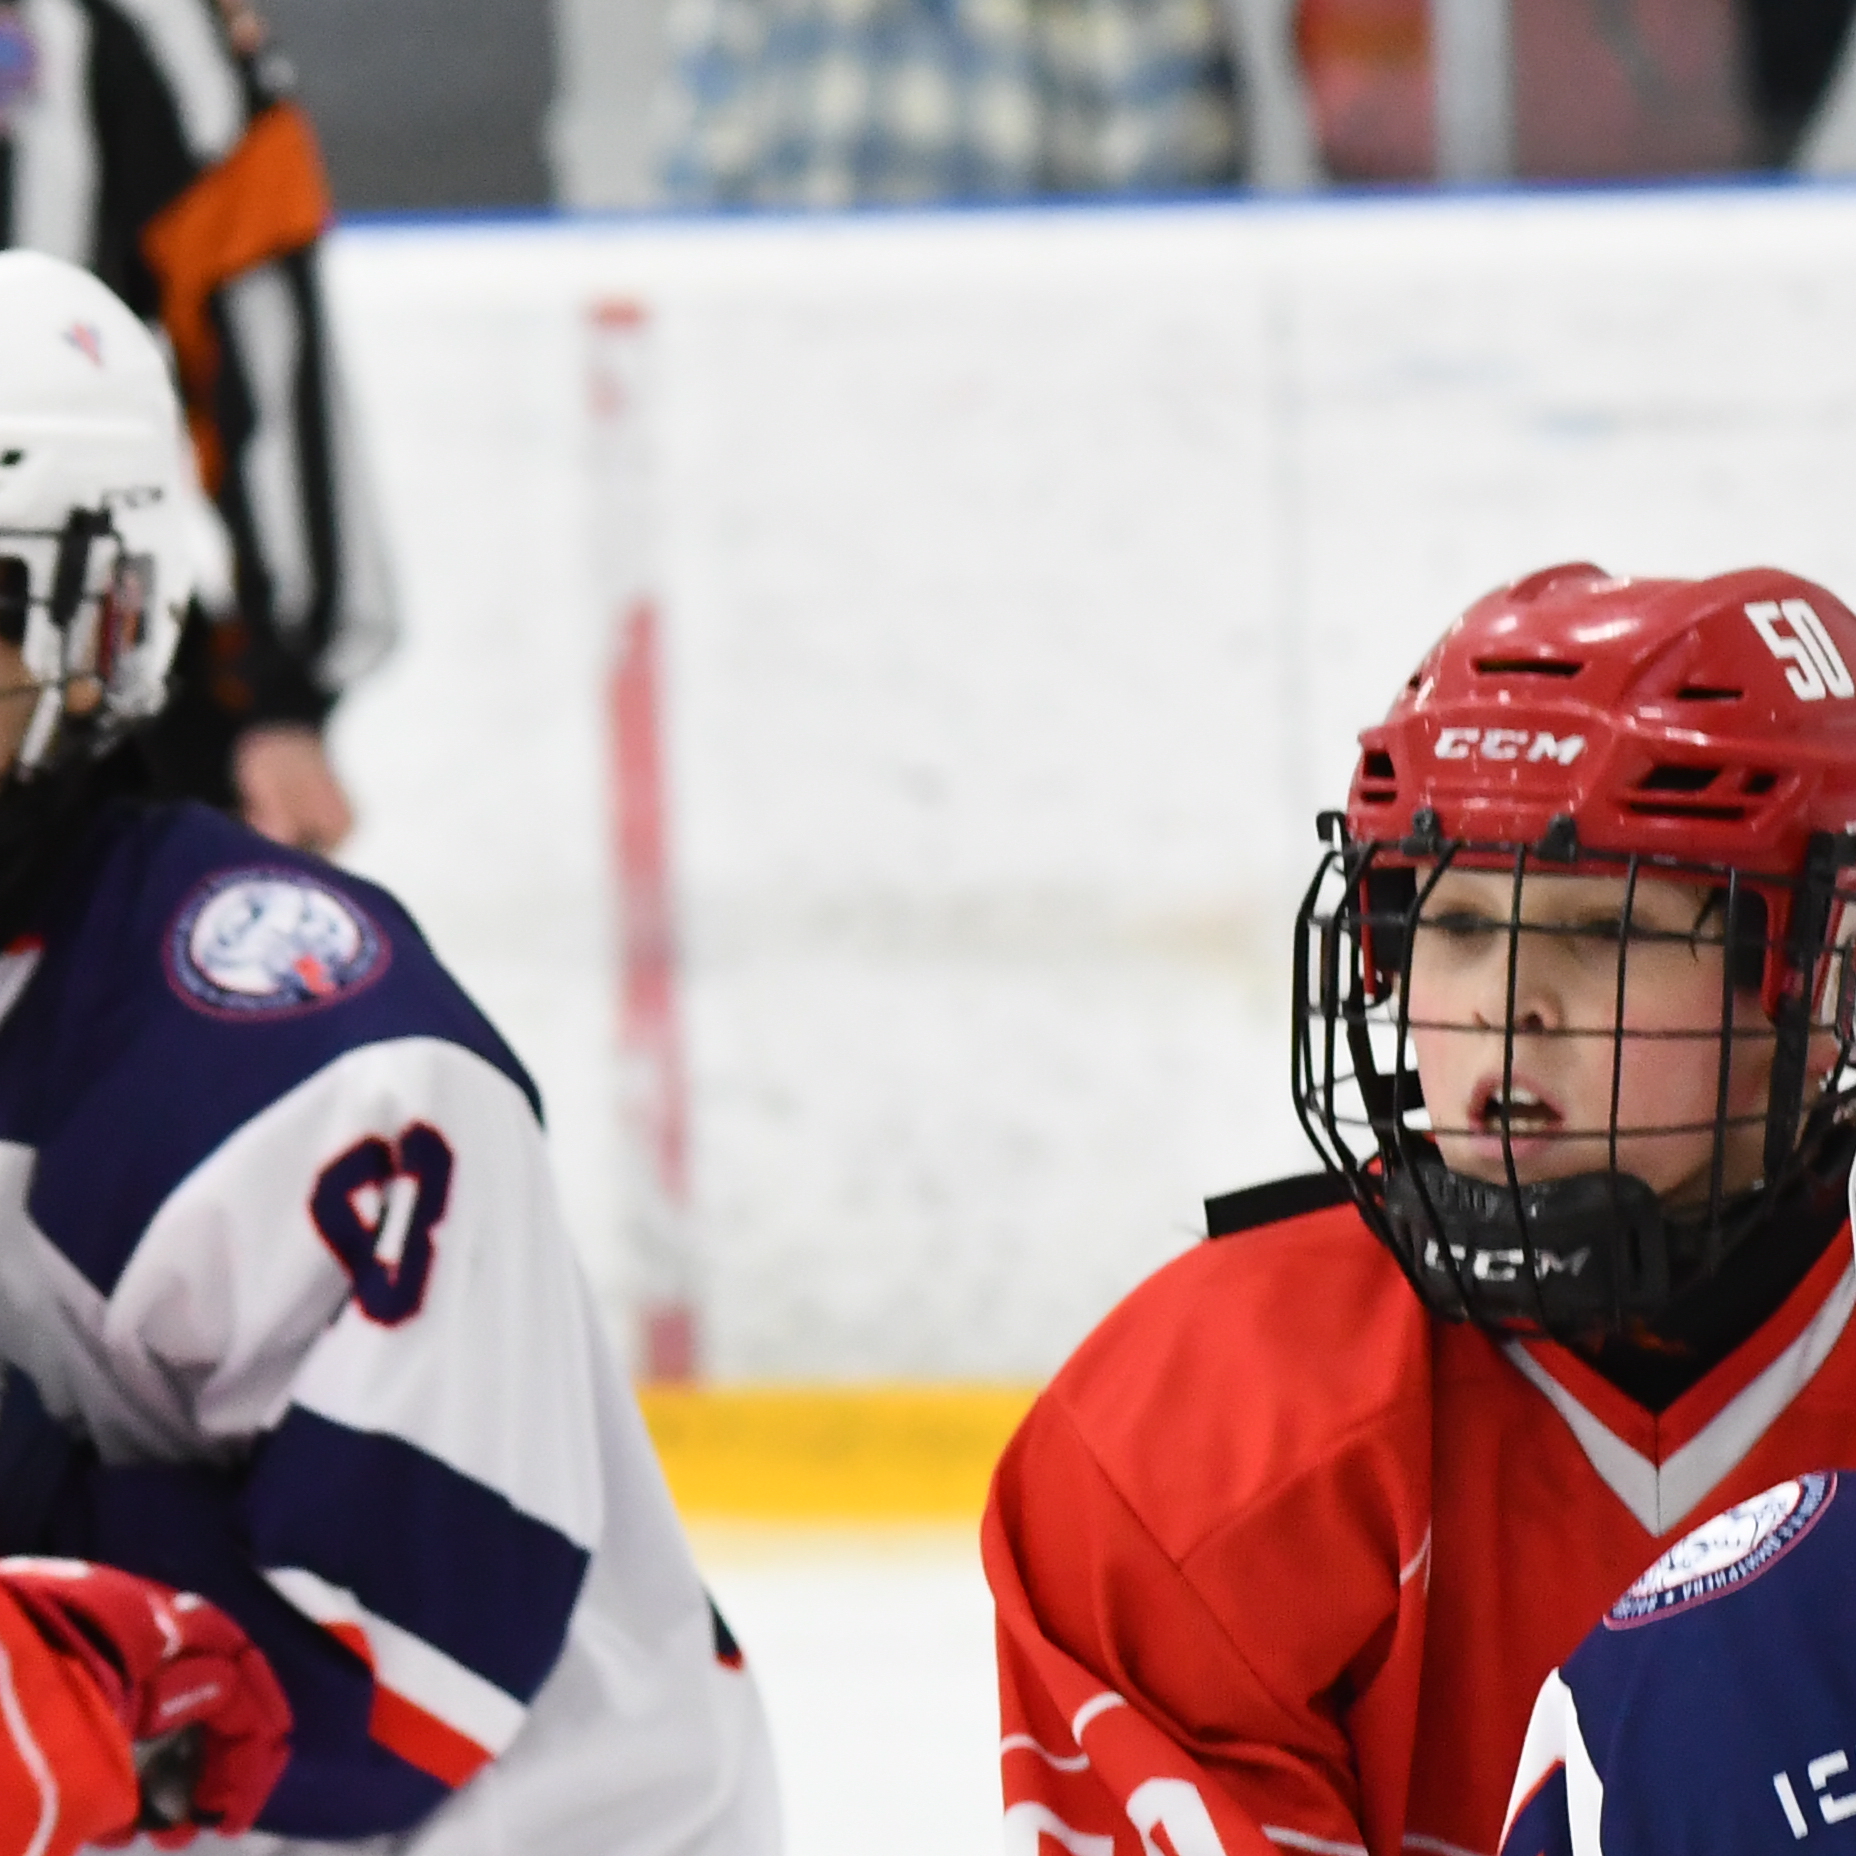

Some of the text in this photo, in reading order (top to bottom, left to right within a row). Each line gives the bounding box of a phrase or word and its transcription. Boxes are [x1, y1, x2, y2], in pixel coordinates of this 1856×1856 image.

[1745, 598, 1856, 702] 50
[1434, 727, 1586, 767] CCM
[1424, 1238, 1591, 1281] CCM
